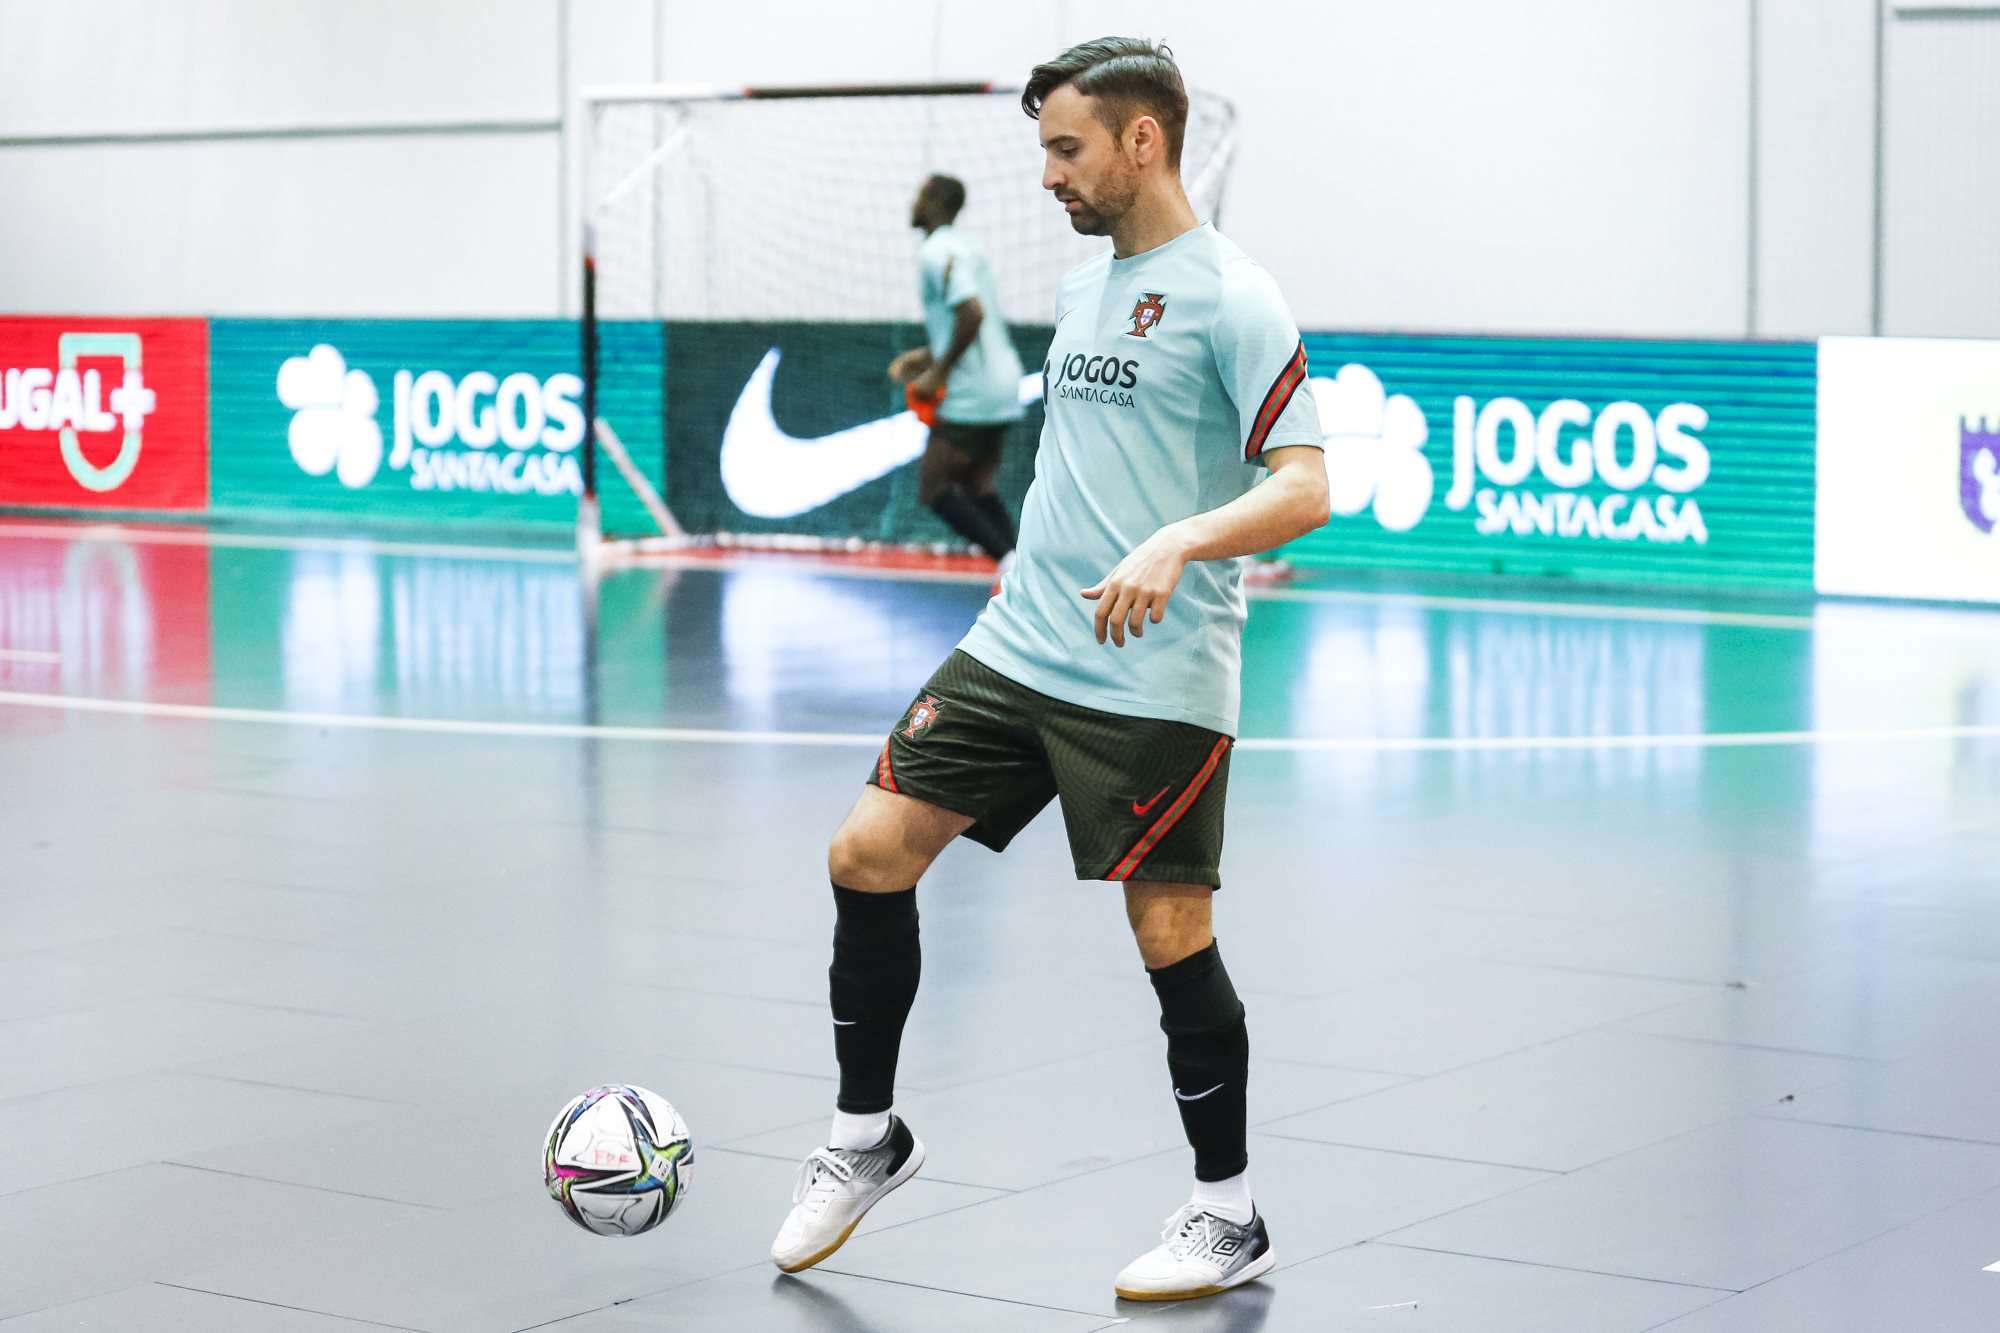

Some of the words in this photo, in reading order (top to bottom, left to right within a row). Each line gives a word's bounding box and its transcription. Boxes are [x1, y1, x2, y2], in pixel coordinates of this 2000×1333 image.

[1054, 353, 1140, 389] JOGOS
[1060, 384, 1135, 408] SANTACASA
[388, 369, 586, 471] JOGOS
[410, 448, 586, 497] SANTACASA
[1446, 395, 1710, 510] JOGOS
[1475, 488, 1709, 544] SANTACASA
